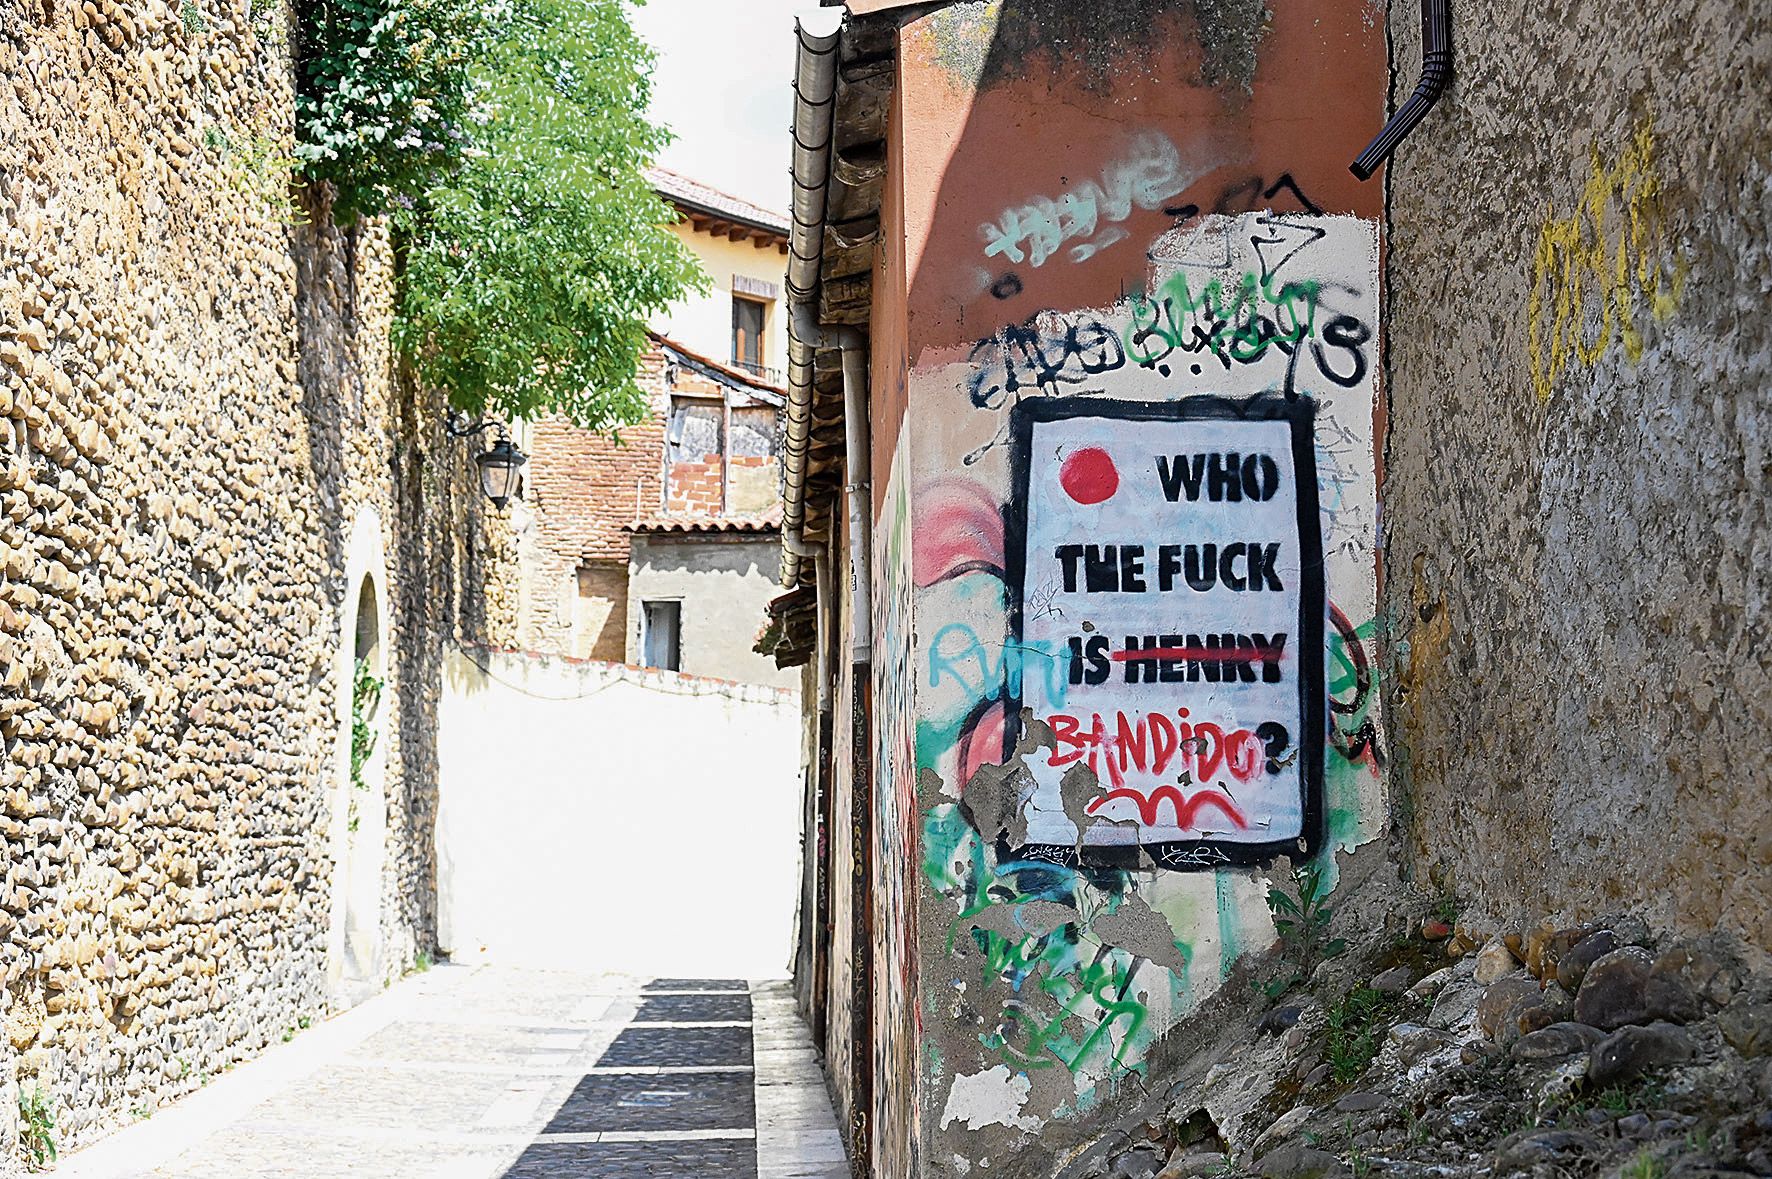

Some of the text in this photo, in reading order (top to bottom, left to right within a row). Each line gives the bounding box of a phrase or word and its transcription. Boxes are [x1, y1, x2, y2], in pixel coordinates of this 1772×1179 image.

[1155, 452, 1280, 503] WHO
[1054, 541, 1285, 593] THE FUCK
[1068, 635, 1112, 685] IS
[1124, 632, 1288, 684] HENRY
